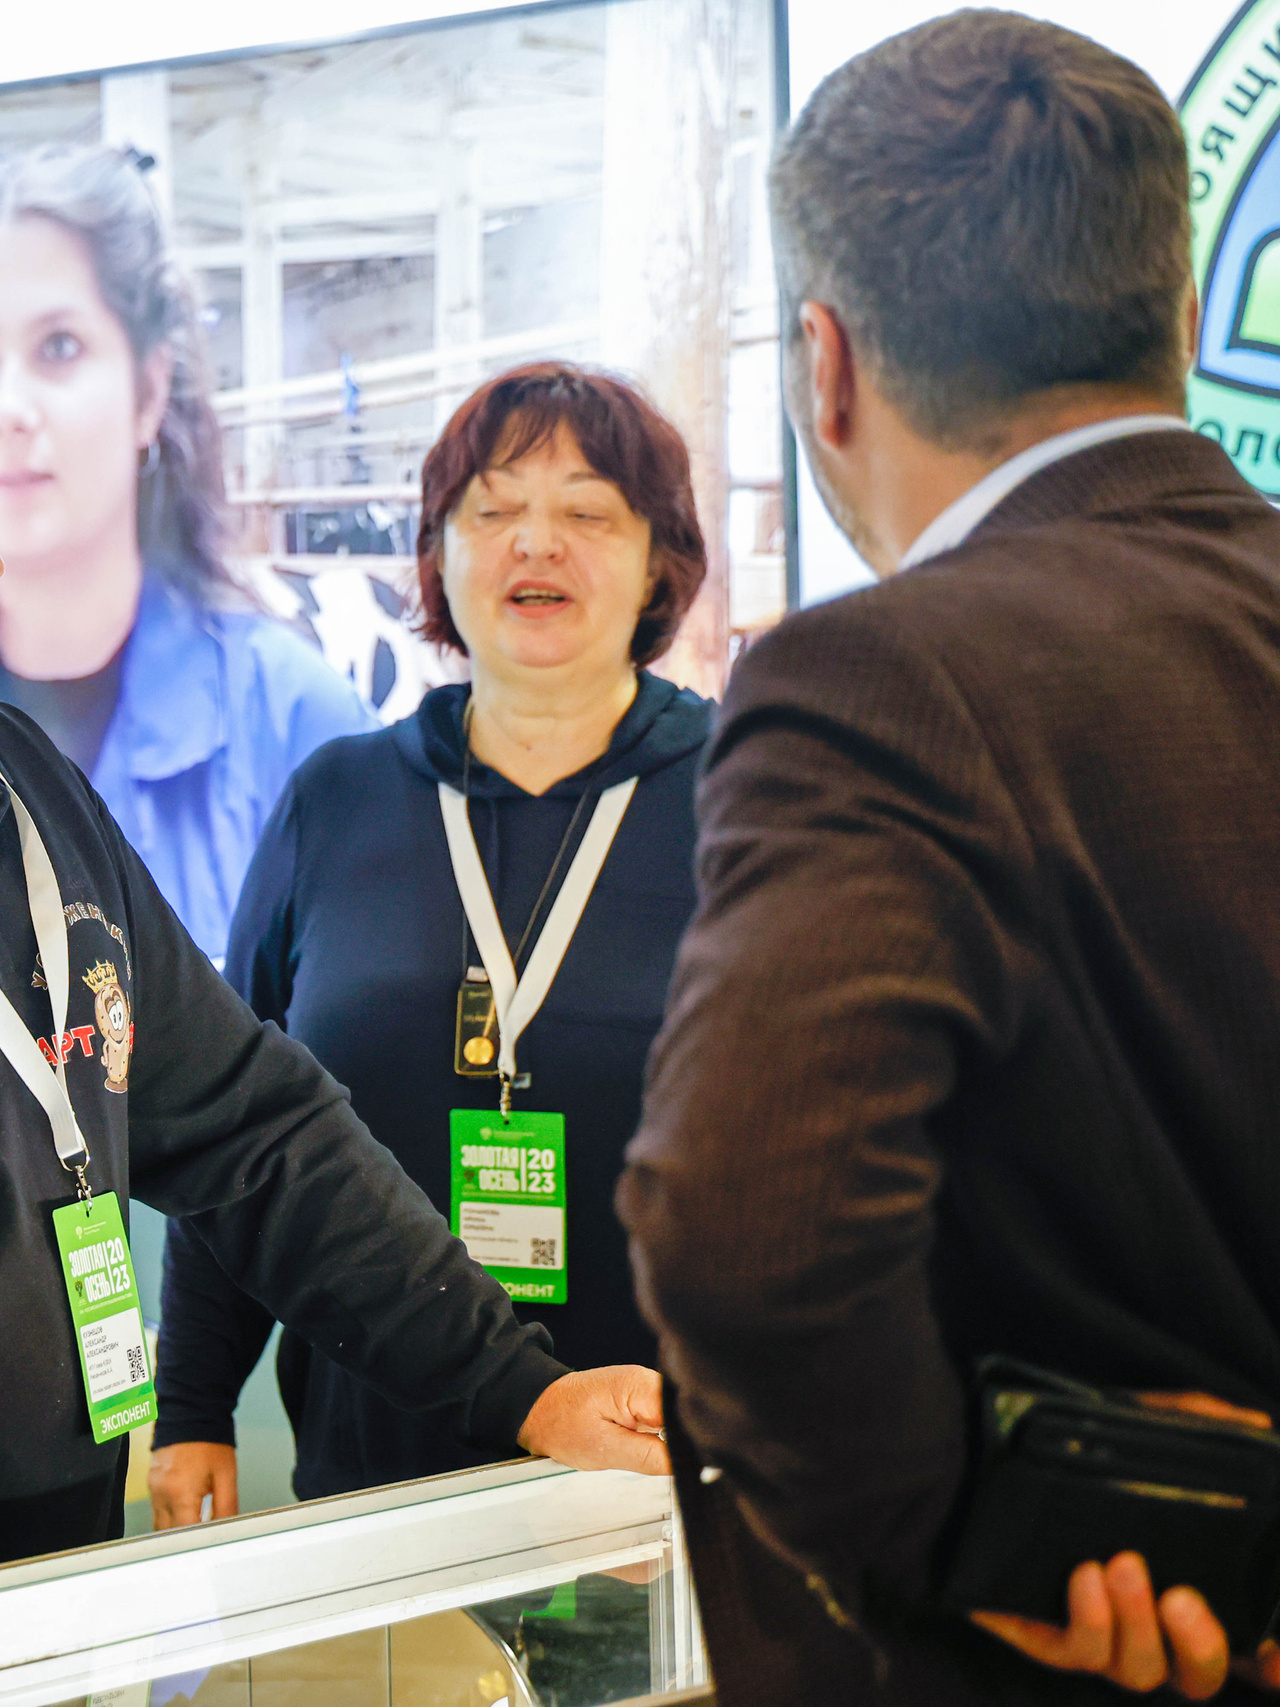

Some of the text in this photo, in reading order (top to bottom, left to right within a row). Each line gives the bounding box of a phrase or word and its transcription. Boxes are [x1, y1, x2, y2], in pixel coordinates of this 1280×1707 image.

[527, 1147, 555, 1171] 20
[527, 1171, 556, 1194] 23
[68, 1242, 106, 1278] ЗОЛОТАЯ
[107, 1236, 125, 1265] 20
[84, 1271, 111, 1303] ОСЕНЬ
[112, 1264, 131, 1293] 23
[500, 1281, 556, 1298] ОНЕНТ
[100, 1401, 151, 1435] ЭКСПОНЕНТ
